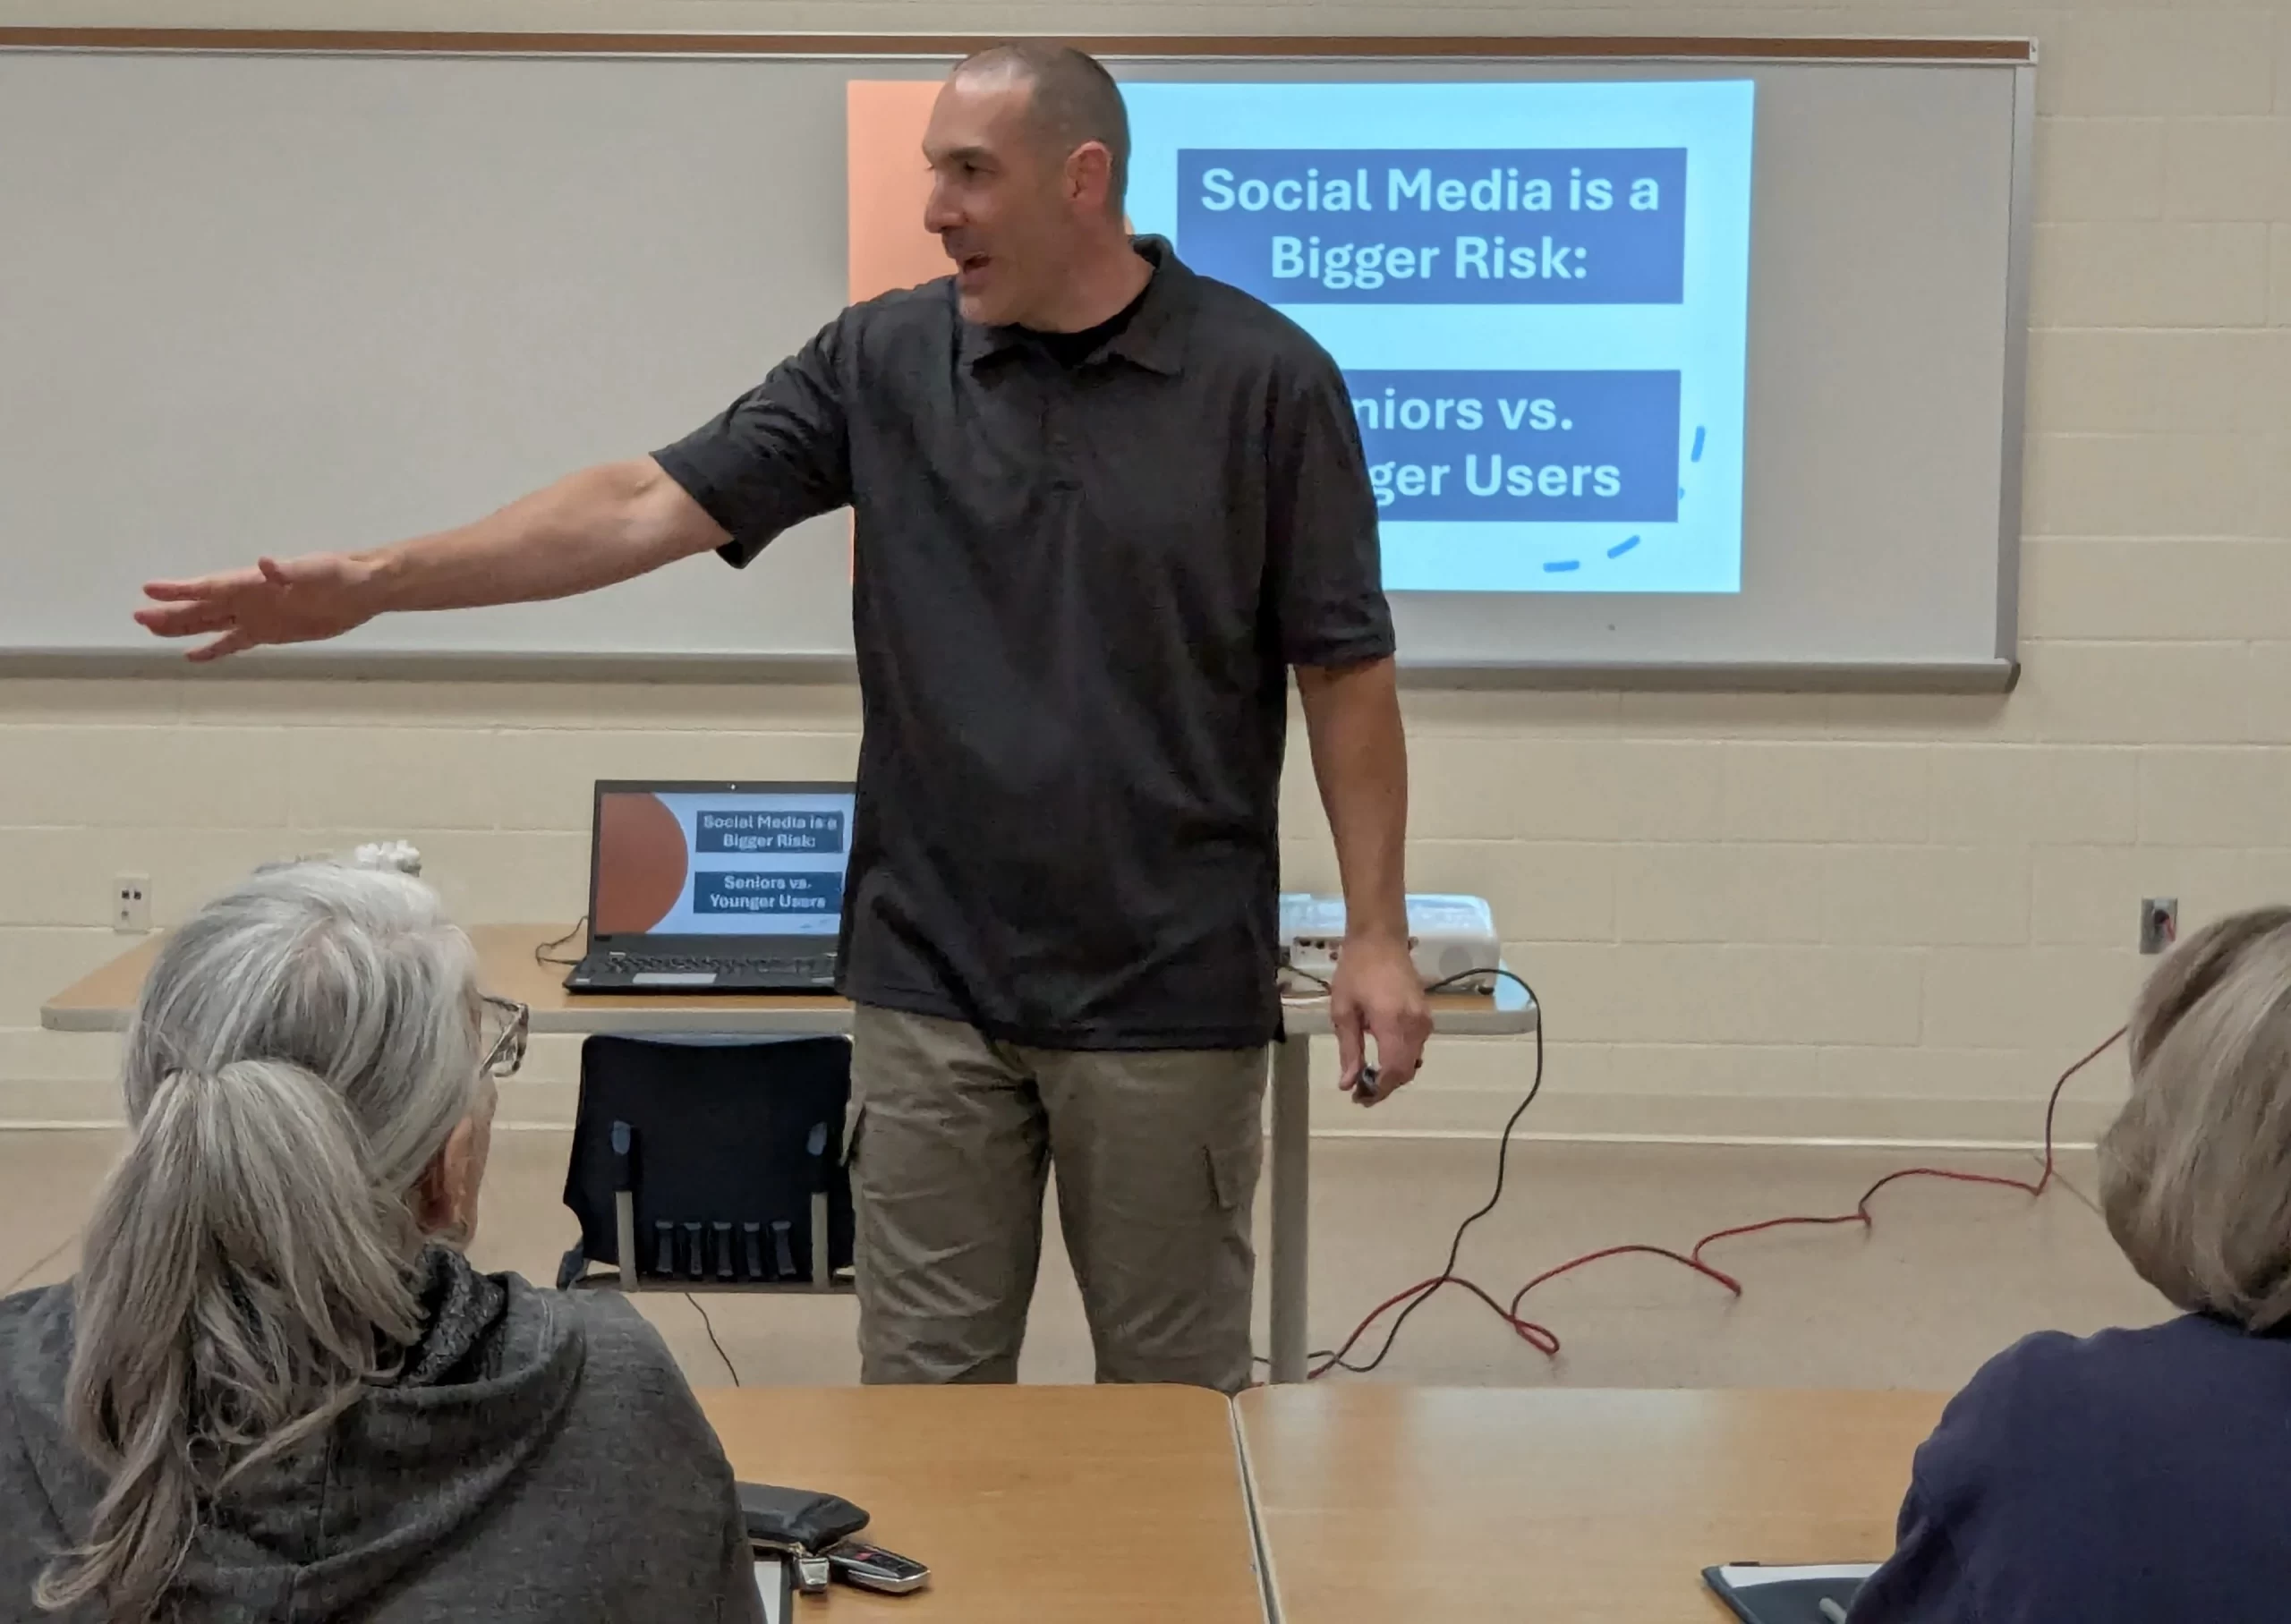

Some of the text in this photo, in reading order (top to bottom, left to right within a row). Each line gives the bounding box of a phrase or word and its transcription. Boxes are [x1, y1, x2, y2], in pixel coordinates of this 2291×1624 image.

[1202, 167, 1659, 212] Social Media is a
[1272, 235, 1587, 290] Bigger Risk:
[1351, 387, 1573, 430] niors vs.
[1466, 454, 1621, 497] Users
[703, 814, 838, 830] Social Media is a
[723, 833, 815, 850] Bigger Risk:
[724, 875, 812, 889] Seniors vs.
[710, 893, 826, 911] Younger Users
